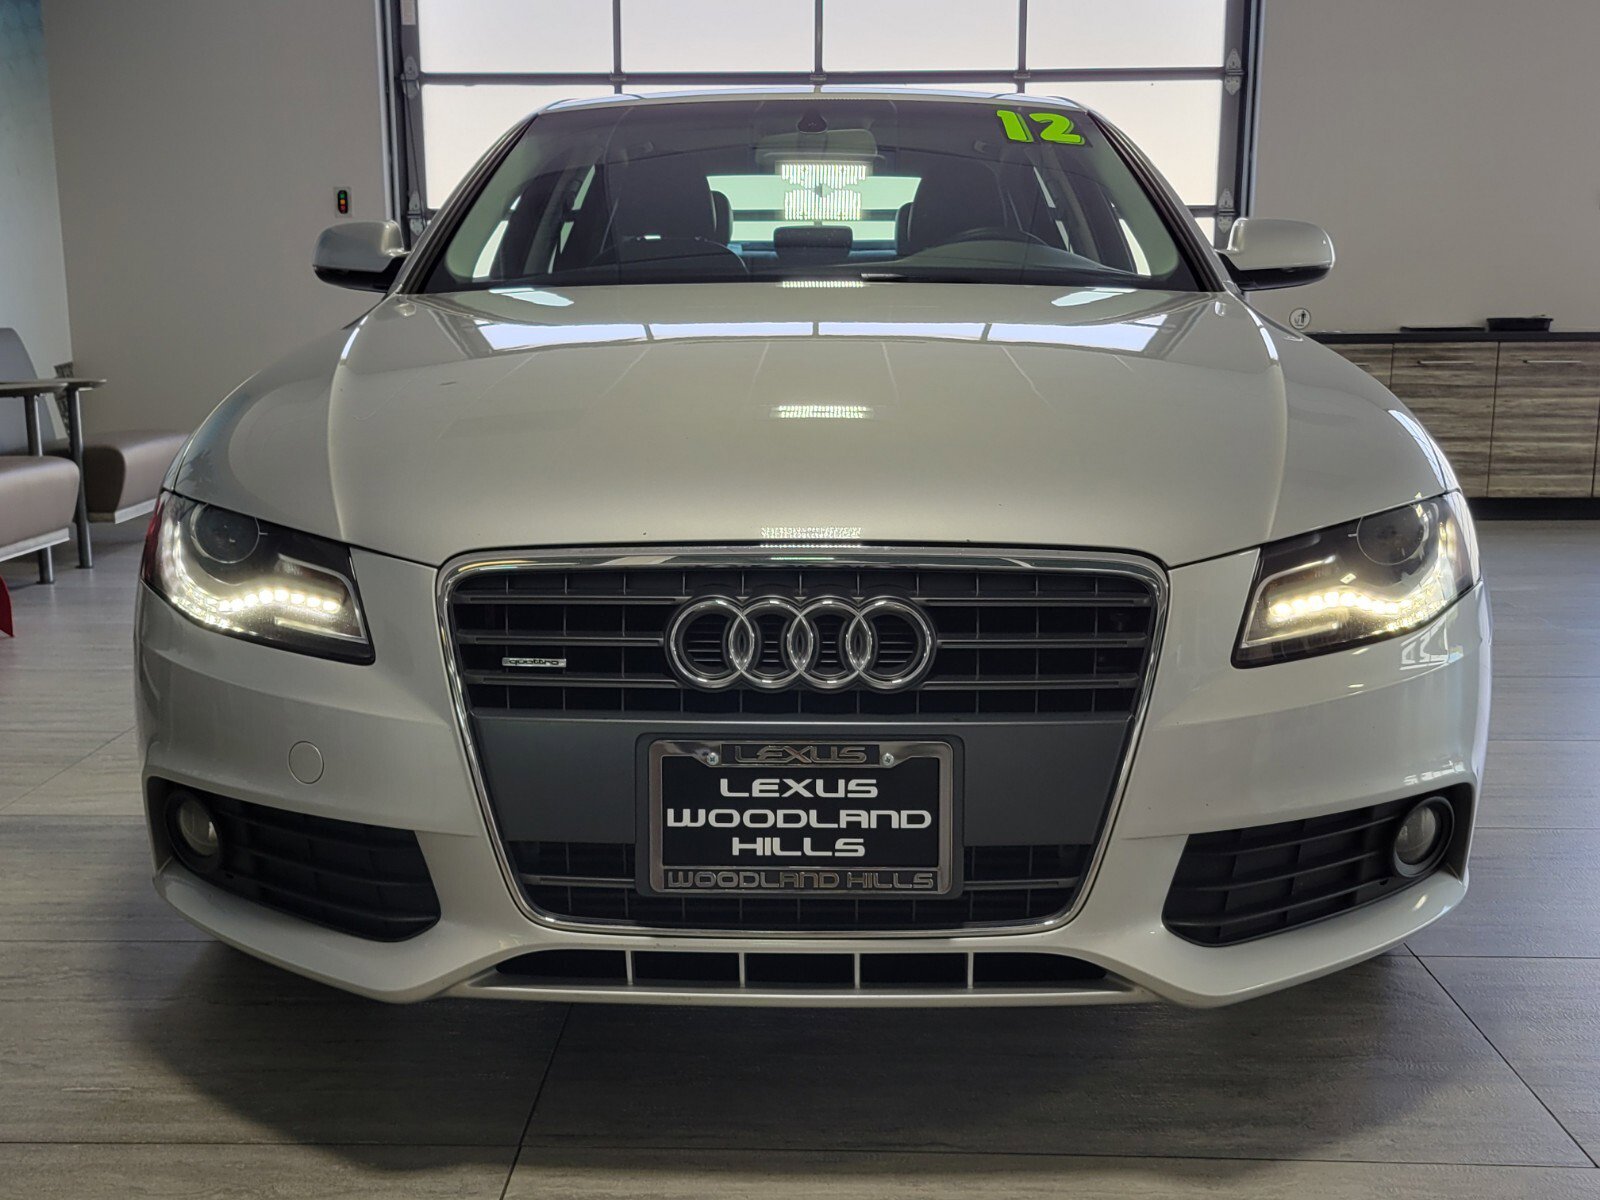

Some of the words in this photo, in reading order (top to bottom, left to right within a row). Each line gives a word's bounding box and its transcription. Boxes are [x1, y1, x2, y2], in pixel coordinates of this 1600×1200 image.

[997, 109, 1085, 145] 12
[734, 745, 867, 763] LEXUS
[720, 778, 878, 798] LEXUS
[667, 808, 932, 829] WOODLAND
[732, 837, 865, 857] HILLS
[668, 871, 840, 888] WOODLAND
[846, 872, 933, 888] HILLS
